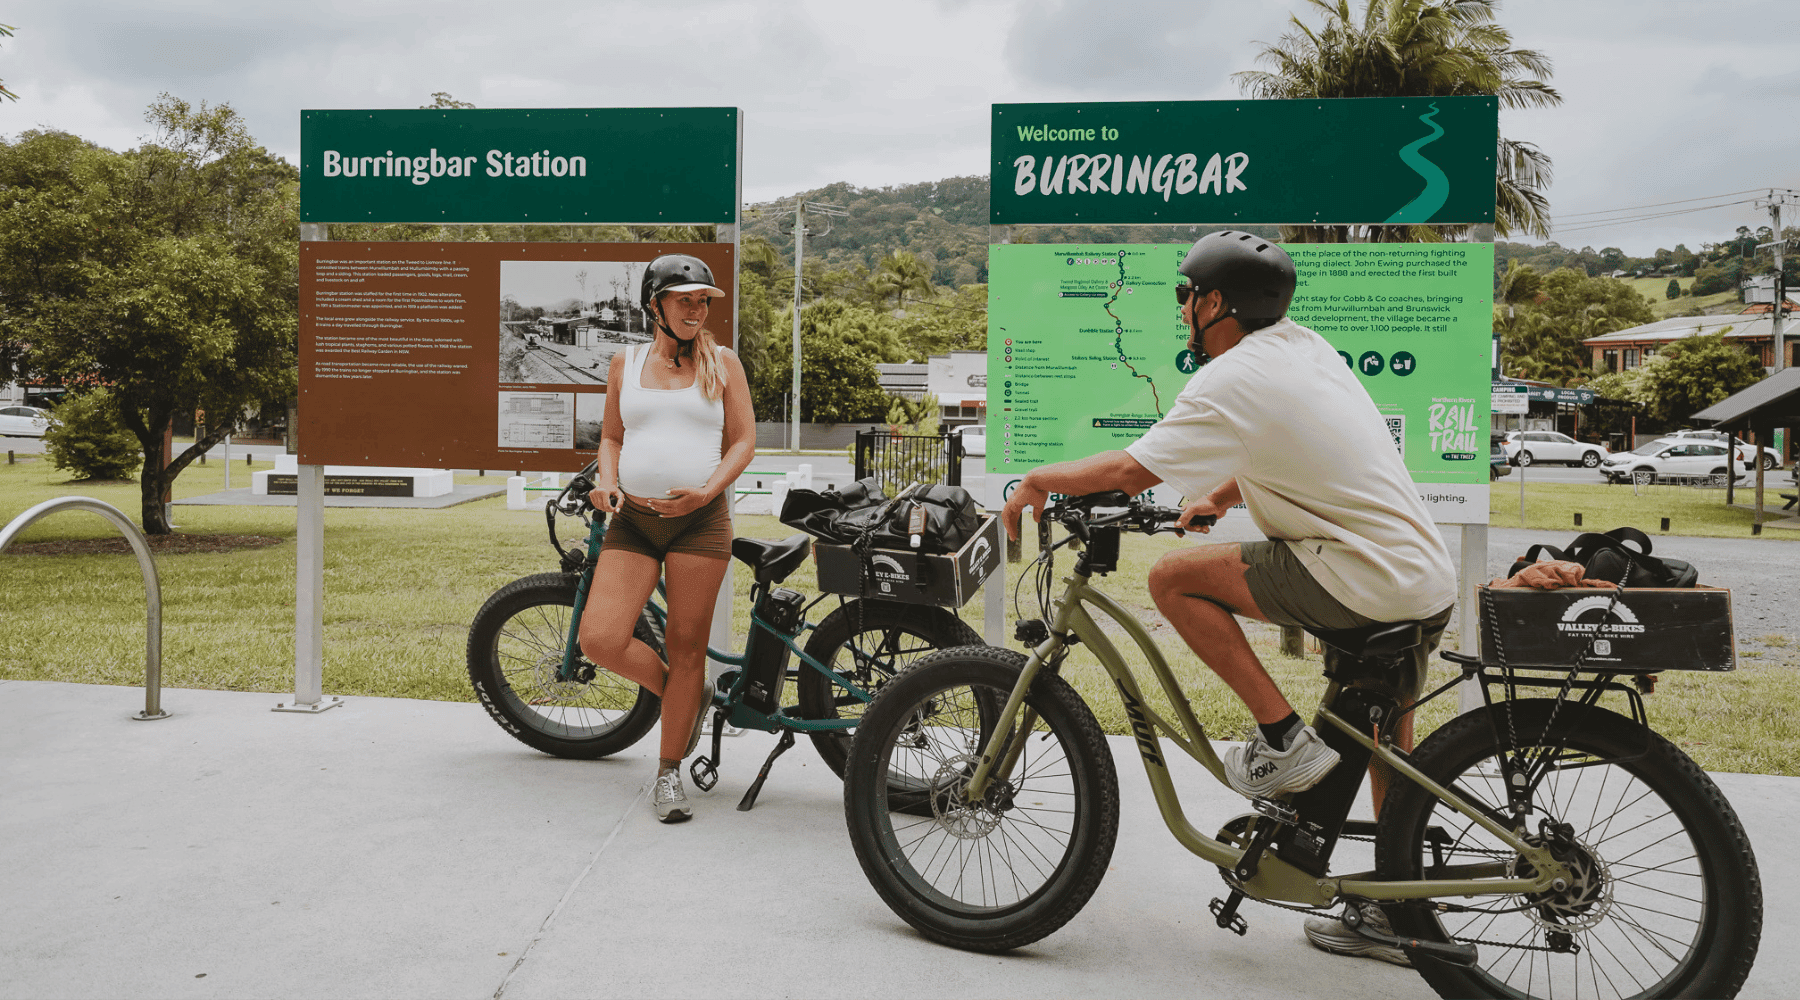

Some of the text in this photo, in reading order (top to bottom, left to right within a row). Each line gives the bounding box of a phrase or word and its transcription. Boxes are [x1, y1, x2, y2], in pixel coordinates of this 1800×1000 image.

[1017, 124, 1119, 142] Welcome to
[323, 148, 587, 185] Burringbar Station
[1013, 151, 1250, 202] BURRINGBAR
[1319, 250, 1340, 259] place
[1369, 250, 1428, 259] non-returning
[1431, 250, 1465, 258] fighting
[1378, 260, 1403, 268] Ewing
[1406, 259, 1450, 268] purchased
[1311, 295, 1327, 304] stay
[1389, 295, 1424, 304] coaches,
[1427, 295, 1463, 304] bringing
[1312, 315, 1368, 323] development,
[1387, 314, 1414, 323] village
[1371, 325, 1389, 334] 1,100
[1392, 325, 1422, 333] people.
[1428, 403, 1479, 432] RAIL
[1429, 429, 1479, 452] TRAIL
[1427, 493, 1467, 504] lighting.
[1556, 623, 1645, 632] VALLEY E-BIKES
[476, 681, 521, 734] KENDA
[1250, 761, 1278, 781] HOKA
